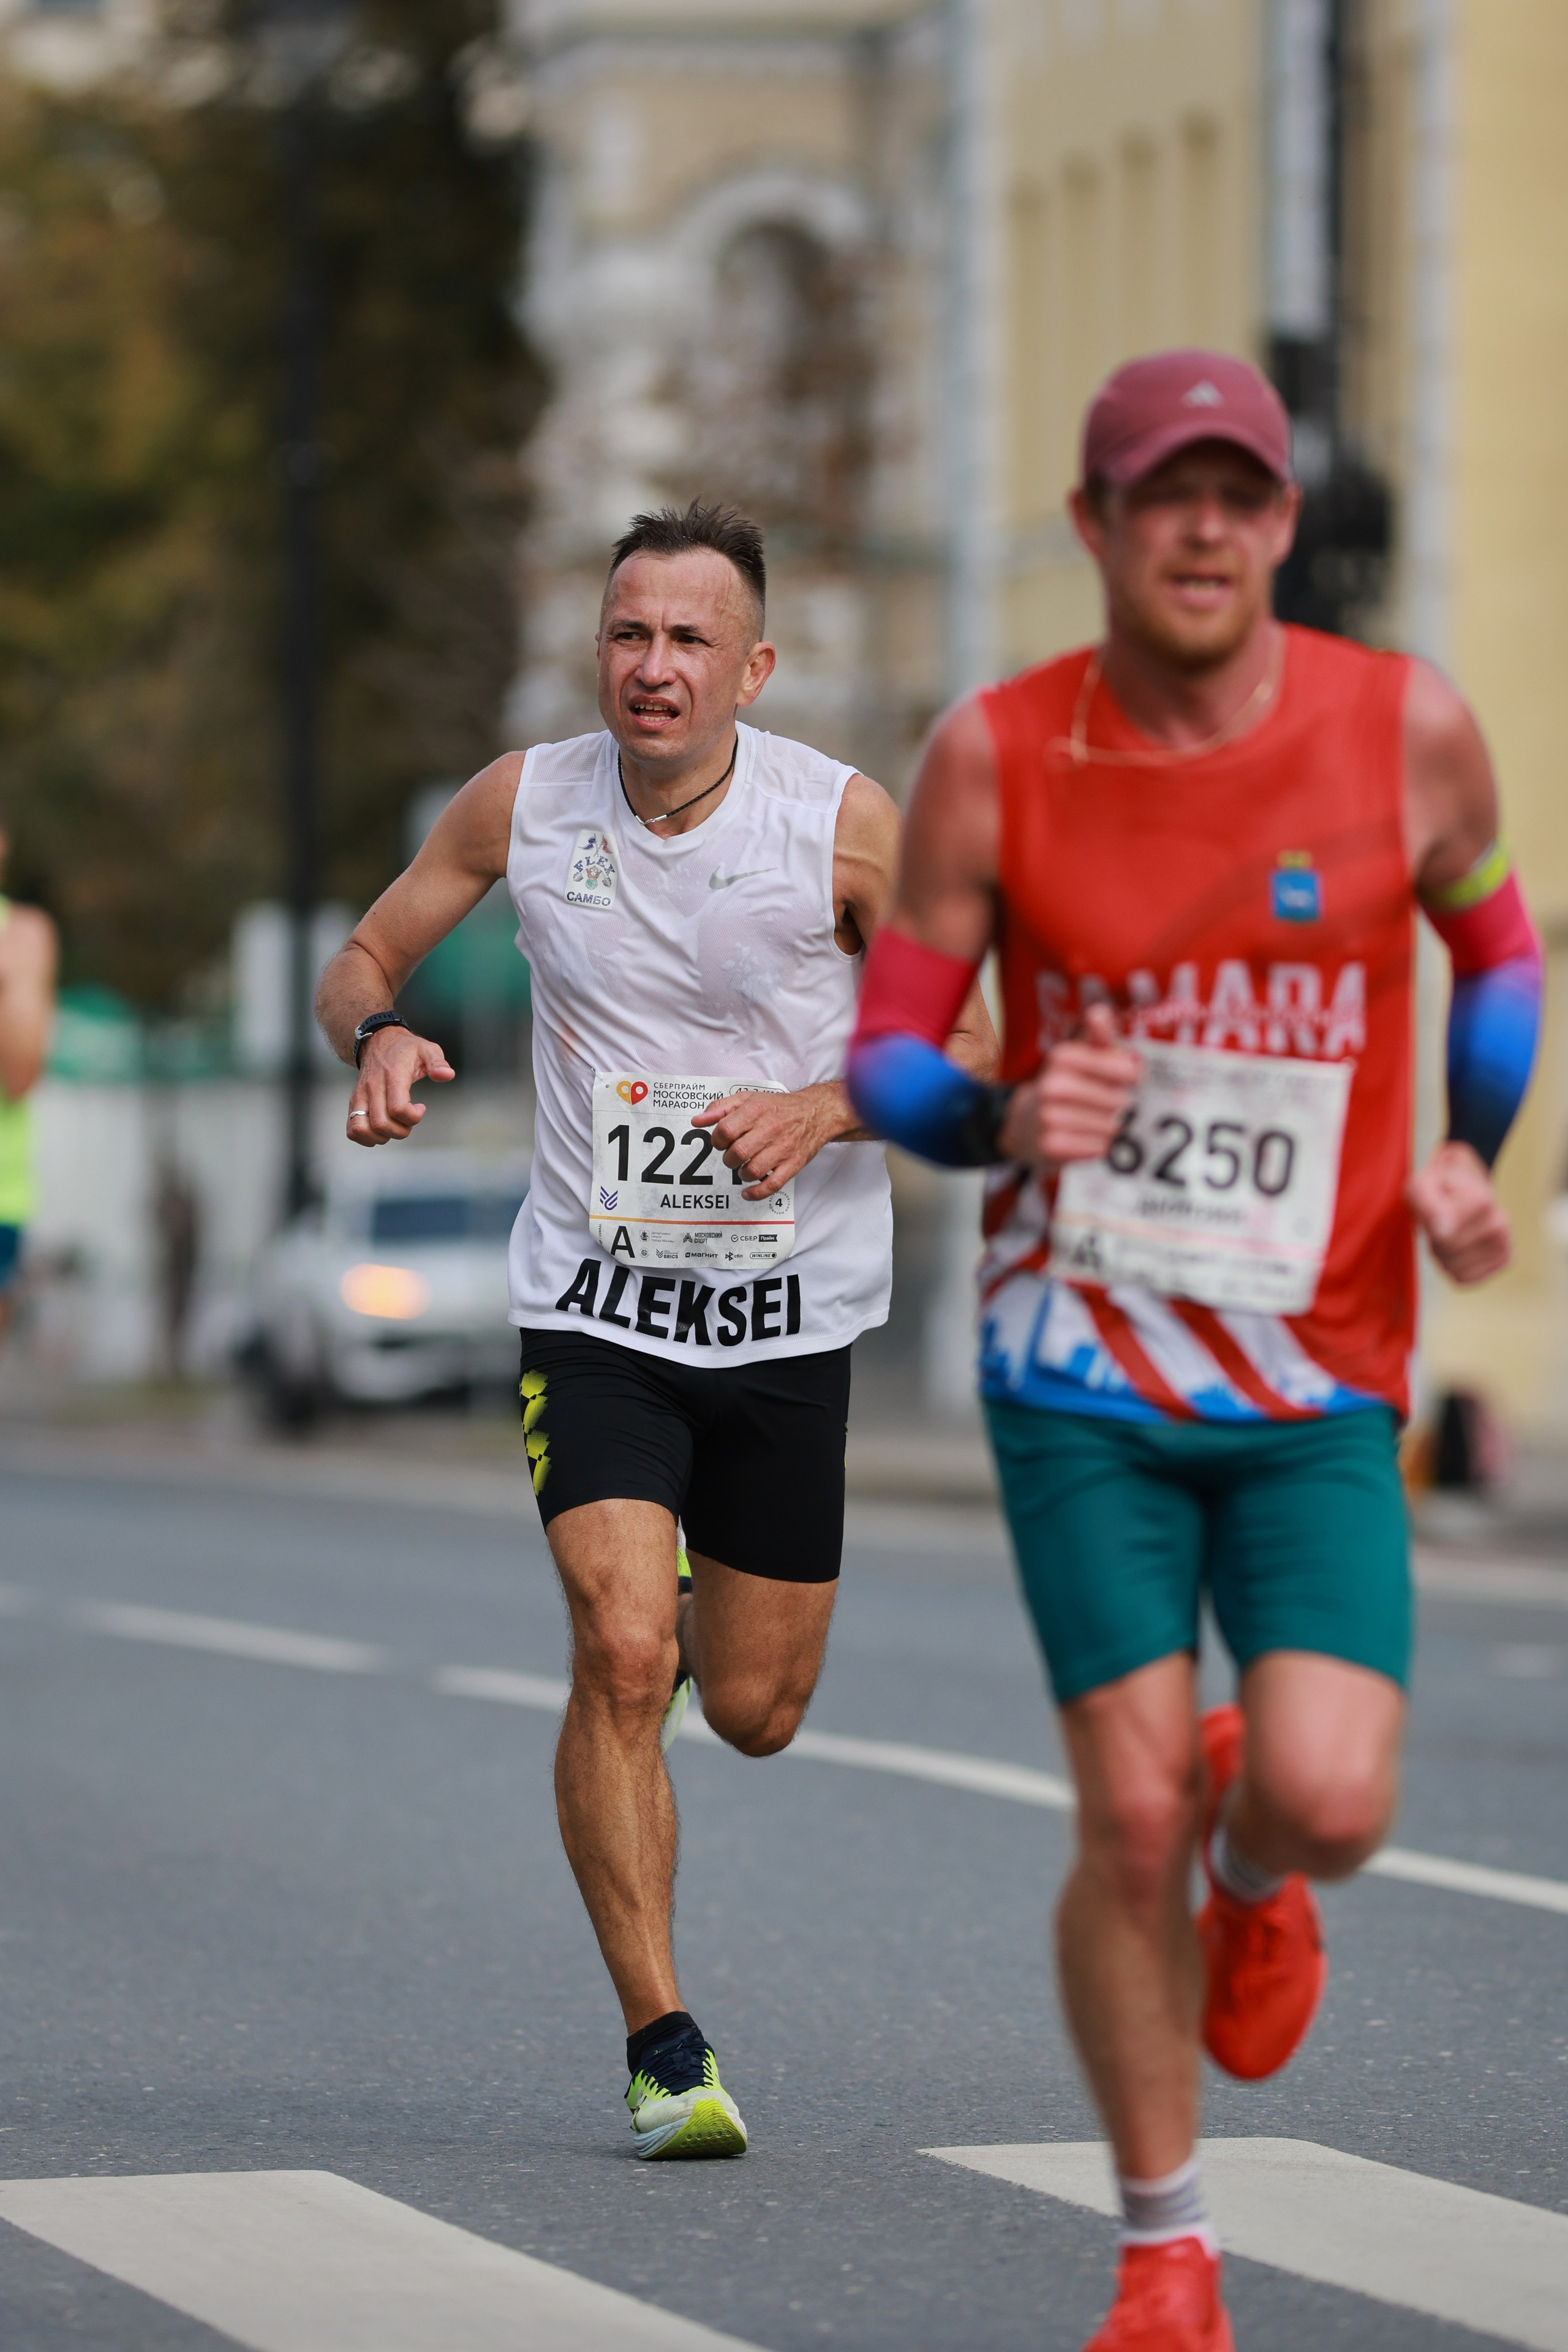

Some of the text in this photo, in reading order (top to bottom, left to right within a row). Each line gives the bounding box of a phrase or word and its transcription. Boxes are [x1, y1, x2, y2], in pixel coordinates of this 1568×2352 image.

[567, 891, 611, 907] САМБО
[654, 1082, 705, 1091] СБЕРПРАЙМ
[653, 1090, 723, 1101] МОСКОВСКИЙ
[653, 1099, 704, 1109] МАРАФОН
[1108, 1107, 1295, 1198] 6250
[660, 1194, 729, 1209] ALEKSEI
[775, 1198, 783, 1207] 4
[611, 1226, 636, 1259] A
[555, 1258, 801, 1347] ALEKSEI
